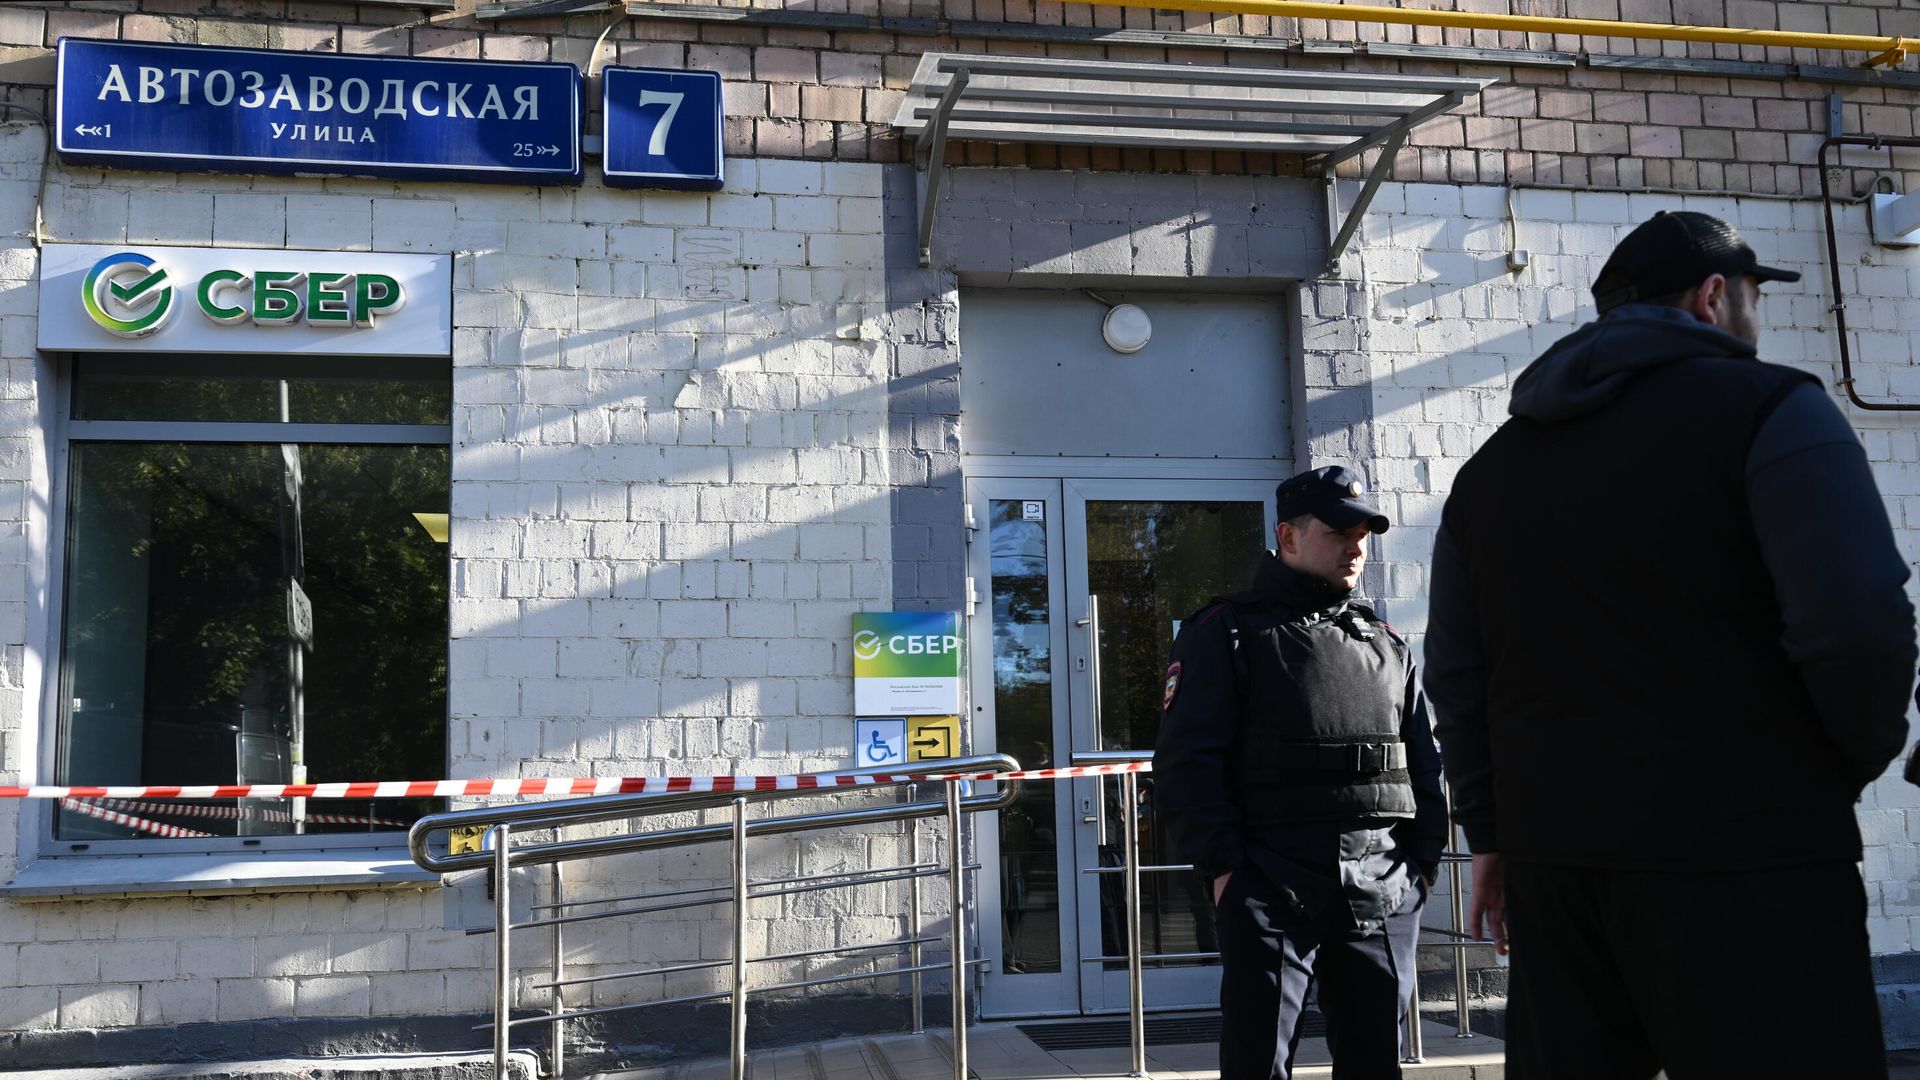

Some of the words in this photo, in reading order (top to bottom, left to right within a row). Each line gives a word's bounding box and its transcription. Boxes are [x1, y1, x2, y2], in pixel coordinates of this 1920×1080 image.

[97, 64, 539, 121] АВТОЗАВОДСКАЯ
[103, 124, 112, 138] 1
[270, 122, 376, 144] УЛИЦА
[639, 89, 685, 156] 7
[513, 143, 534, 157] 25
[197, 269, 402, 327] СБЕР
[889, 635, 959, 655] СБЕР
